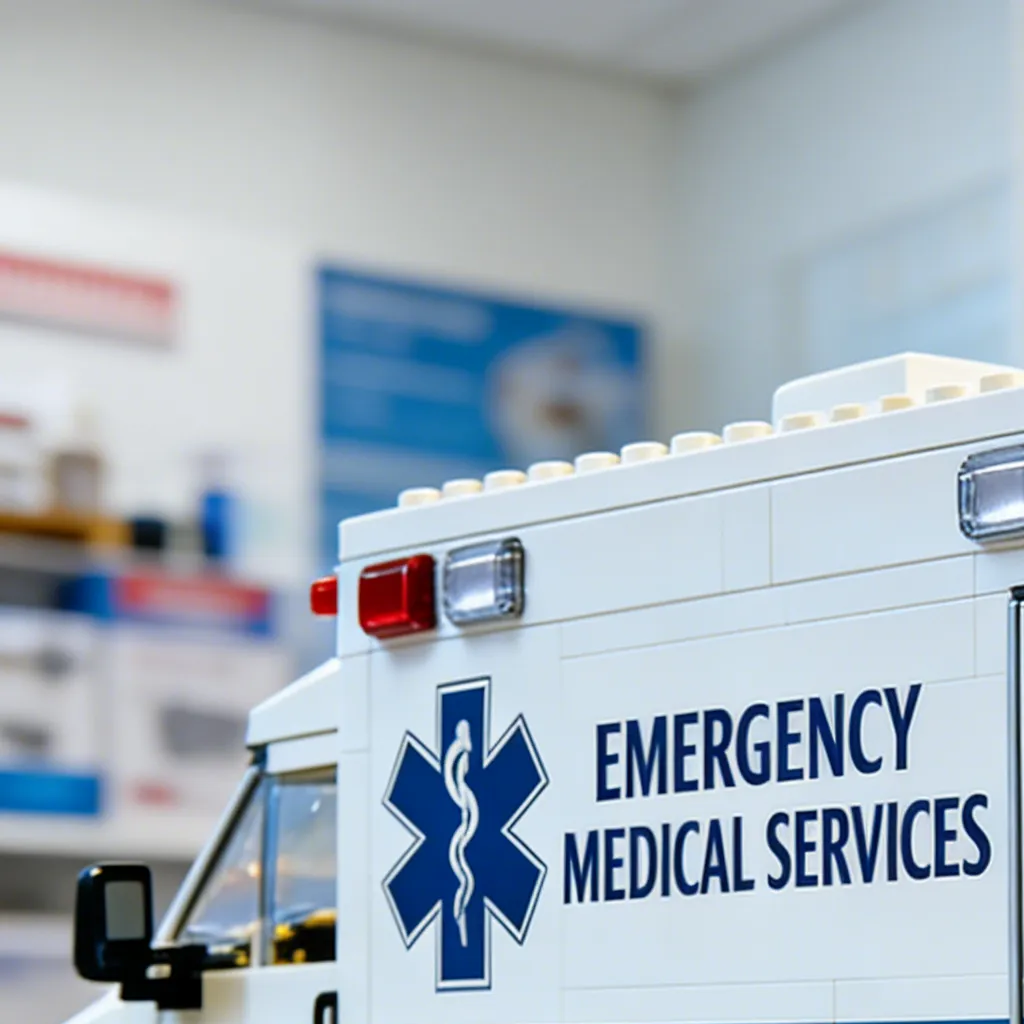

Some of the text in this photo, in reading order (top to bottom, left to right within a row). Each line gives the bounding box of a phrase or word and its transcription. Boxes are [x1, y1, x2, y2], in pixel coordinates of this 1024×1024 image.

[595, 683, 922, 802] EMERGENCY
[563, 793, 992, 904] MEDICAL SERVICES
